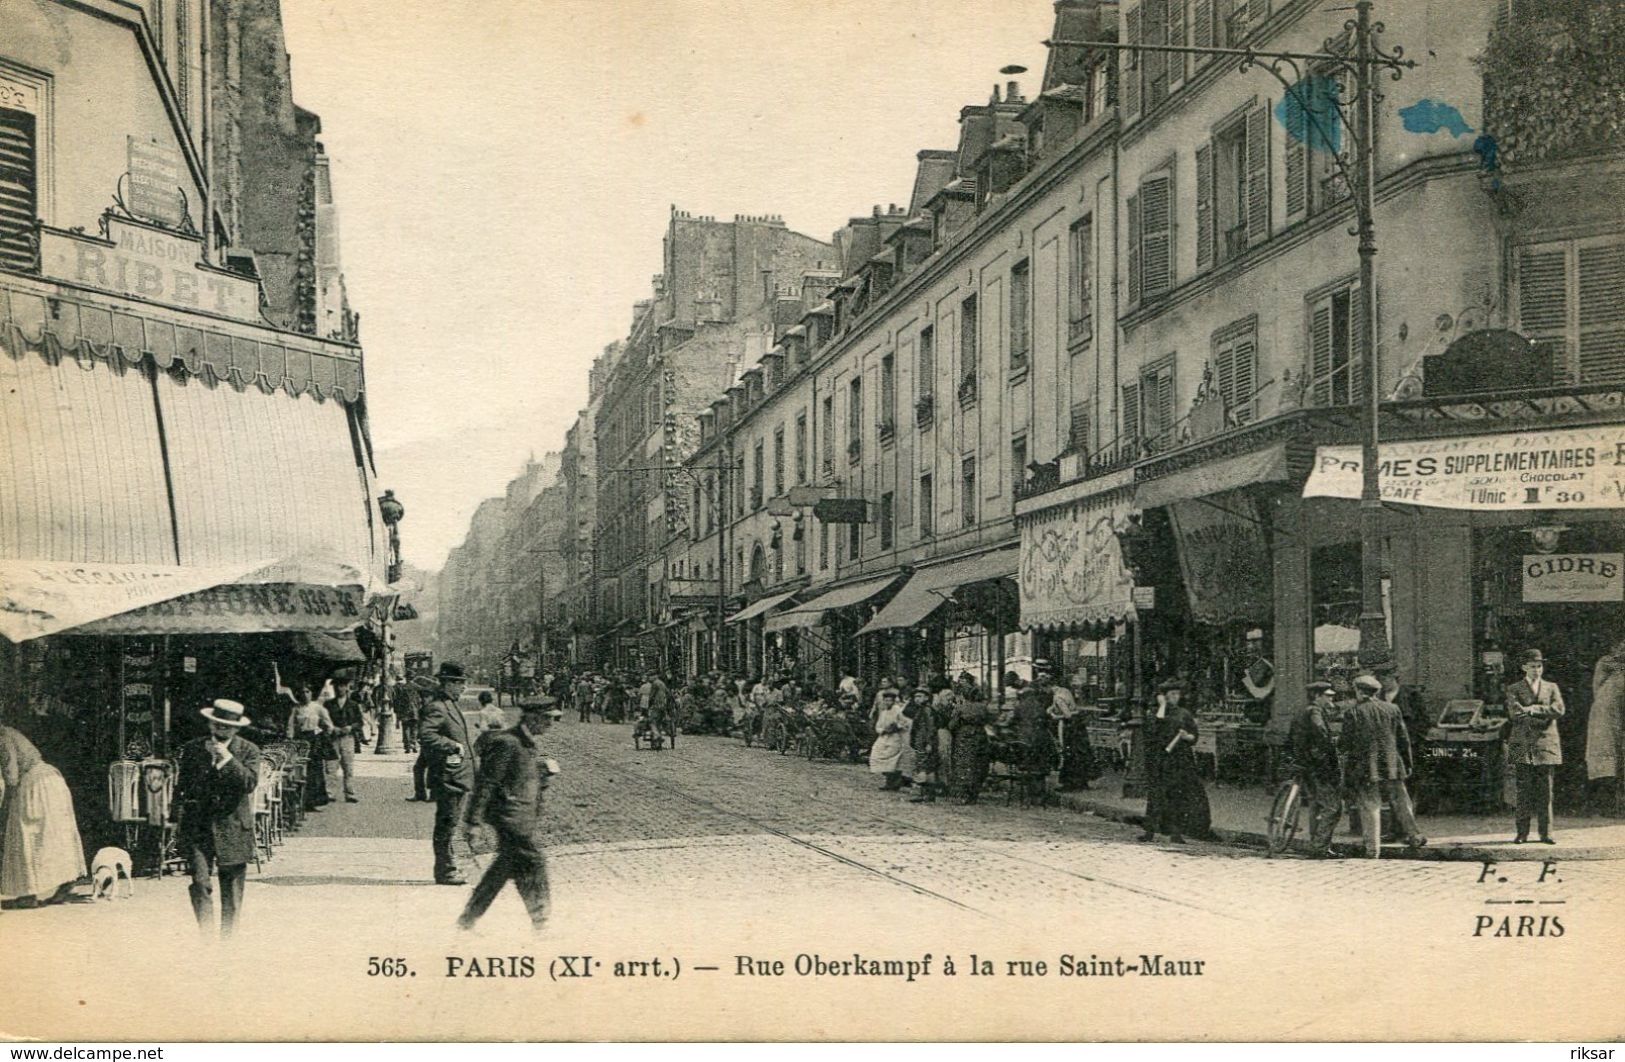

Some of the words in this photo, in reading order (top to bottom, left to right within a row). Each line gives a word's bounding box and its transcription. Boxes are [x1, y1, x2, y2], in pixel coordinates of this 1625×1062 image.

[119, 230, 191, 262] MAISON
[77, 244, 235, 311] RIBET
[1319, 455, 1438, 478] PRMES
[1444, 447, 1596, 475] SUPPLEMENTAIRES
[1556, 491, 1585, 503] 30
[1527, 557, 1617, 579] CIDRE
